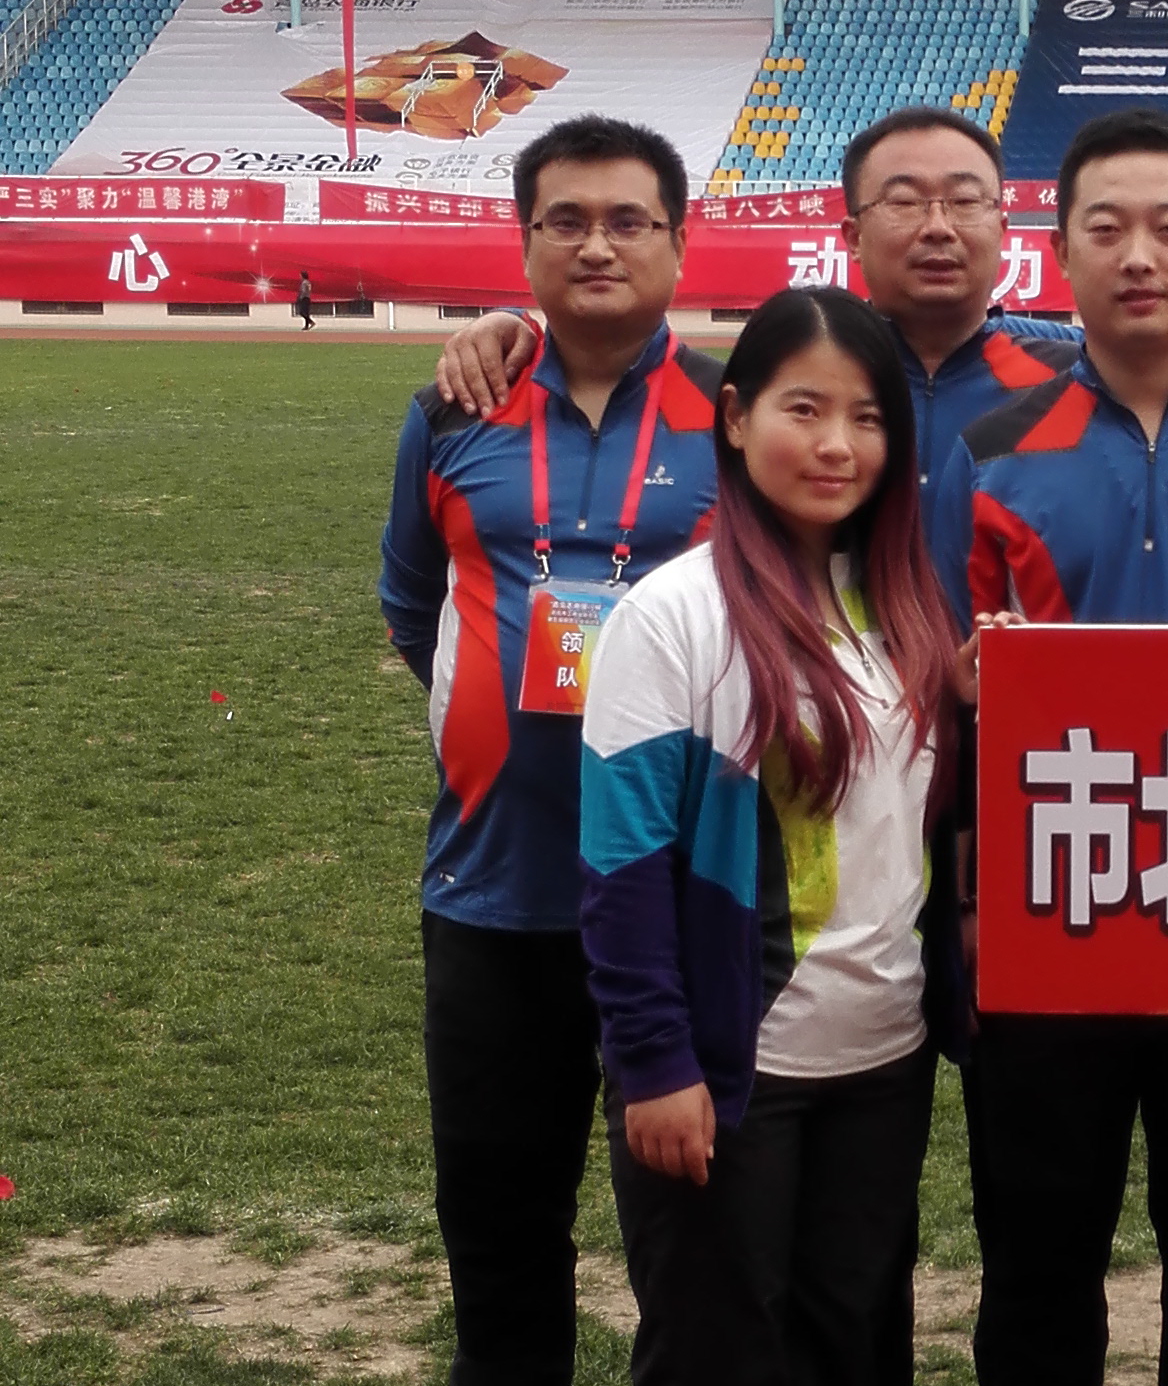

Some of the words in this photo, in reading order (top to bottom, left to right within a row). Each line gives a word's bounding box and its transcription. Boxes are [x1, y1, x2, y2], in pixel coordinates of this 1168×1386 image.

[687, 193, 826, 220] 福八大峡
[108, 233, 171, 292] 心
[556, 631, 586, 689] 领队
